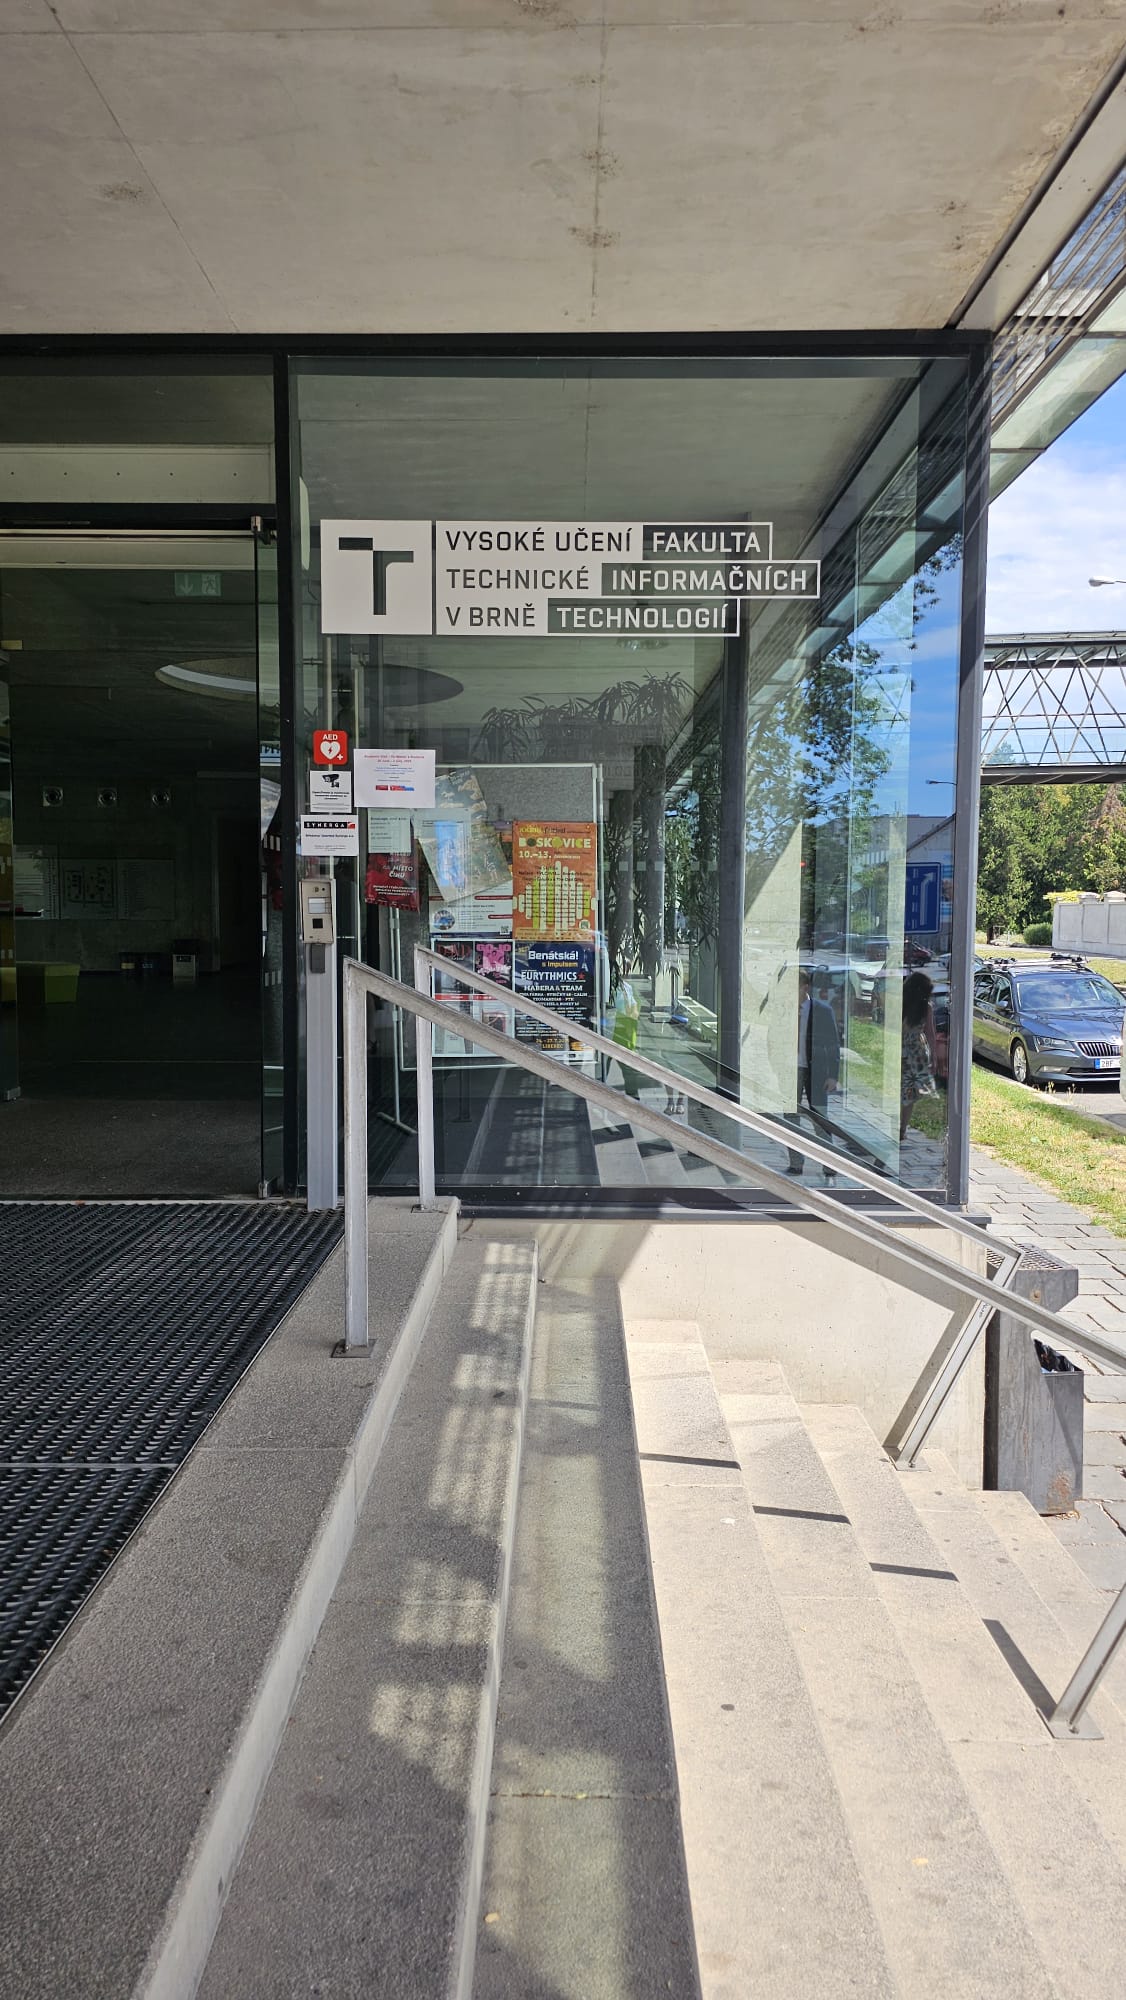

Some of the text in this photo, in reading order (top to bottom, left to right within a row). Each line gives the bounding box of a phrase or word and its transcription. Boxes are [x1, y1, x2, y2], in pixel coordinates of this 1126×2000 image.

[446, 527, 633, 551] VYSOKÉ UČENÍ
[652, 531, 761, 553] FAKULTA
[446, 565, 589, 590] TECHNICKÉ
[612, 565, 807, 591] INFORMAČNÍCH
[446, 603, 536, 627] V BRNĚ
[556, 604, 729, 629] TECHNOLOGIÍ
[518, 836, 592, 849] BOSKOVICE
[528, 950, 579, 960] Benátská!
[521, 971, 577, 980] EURYTHMICS
